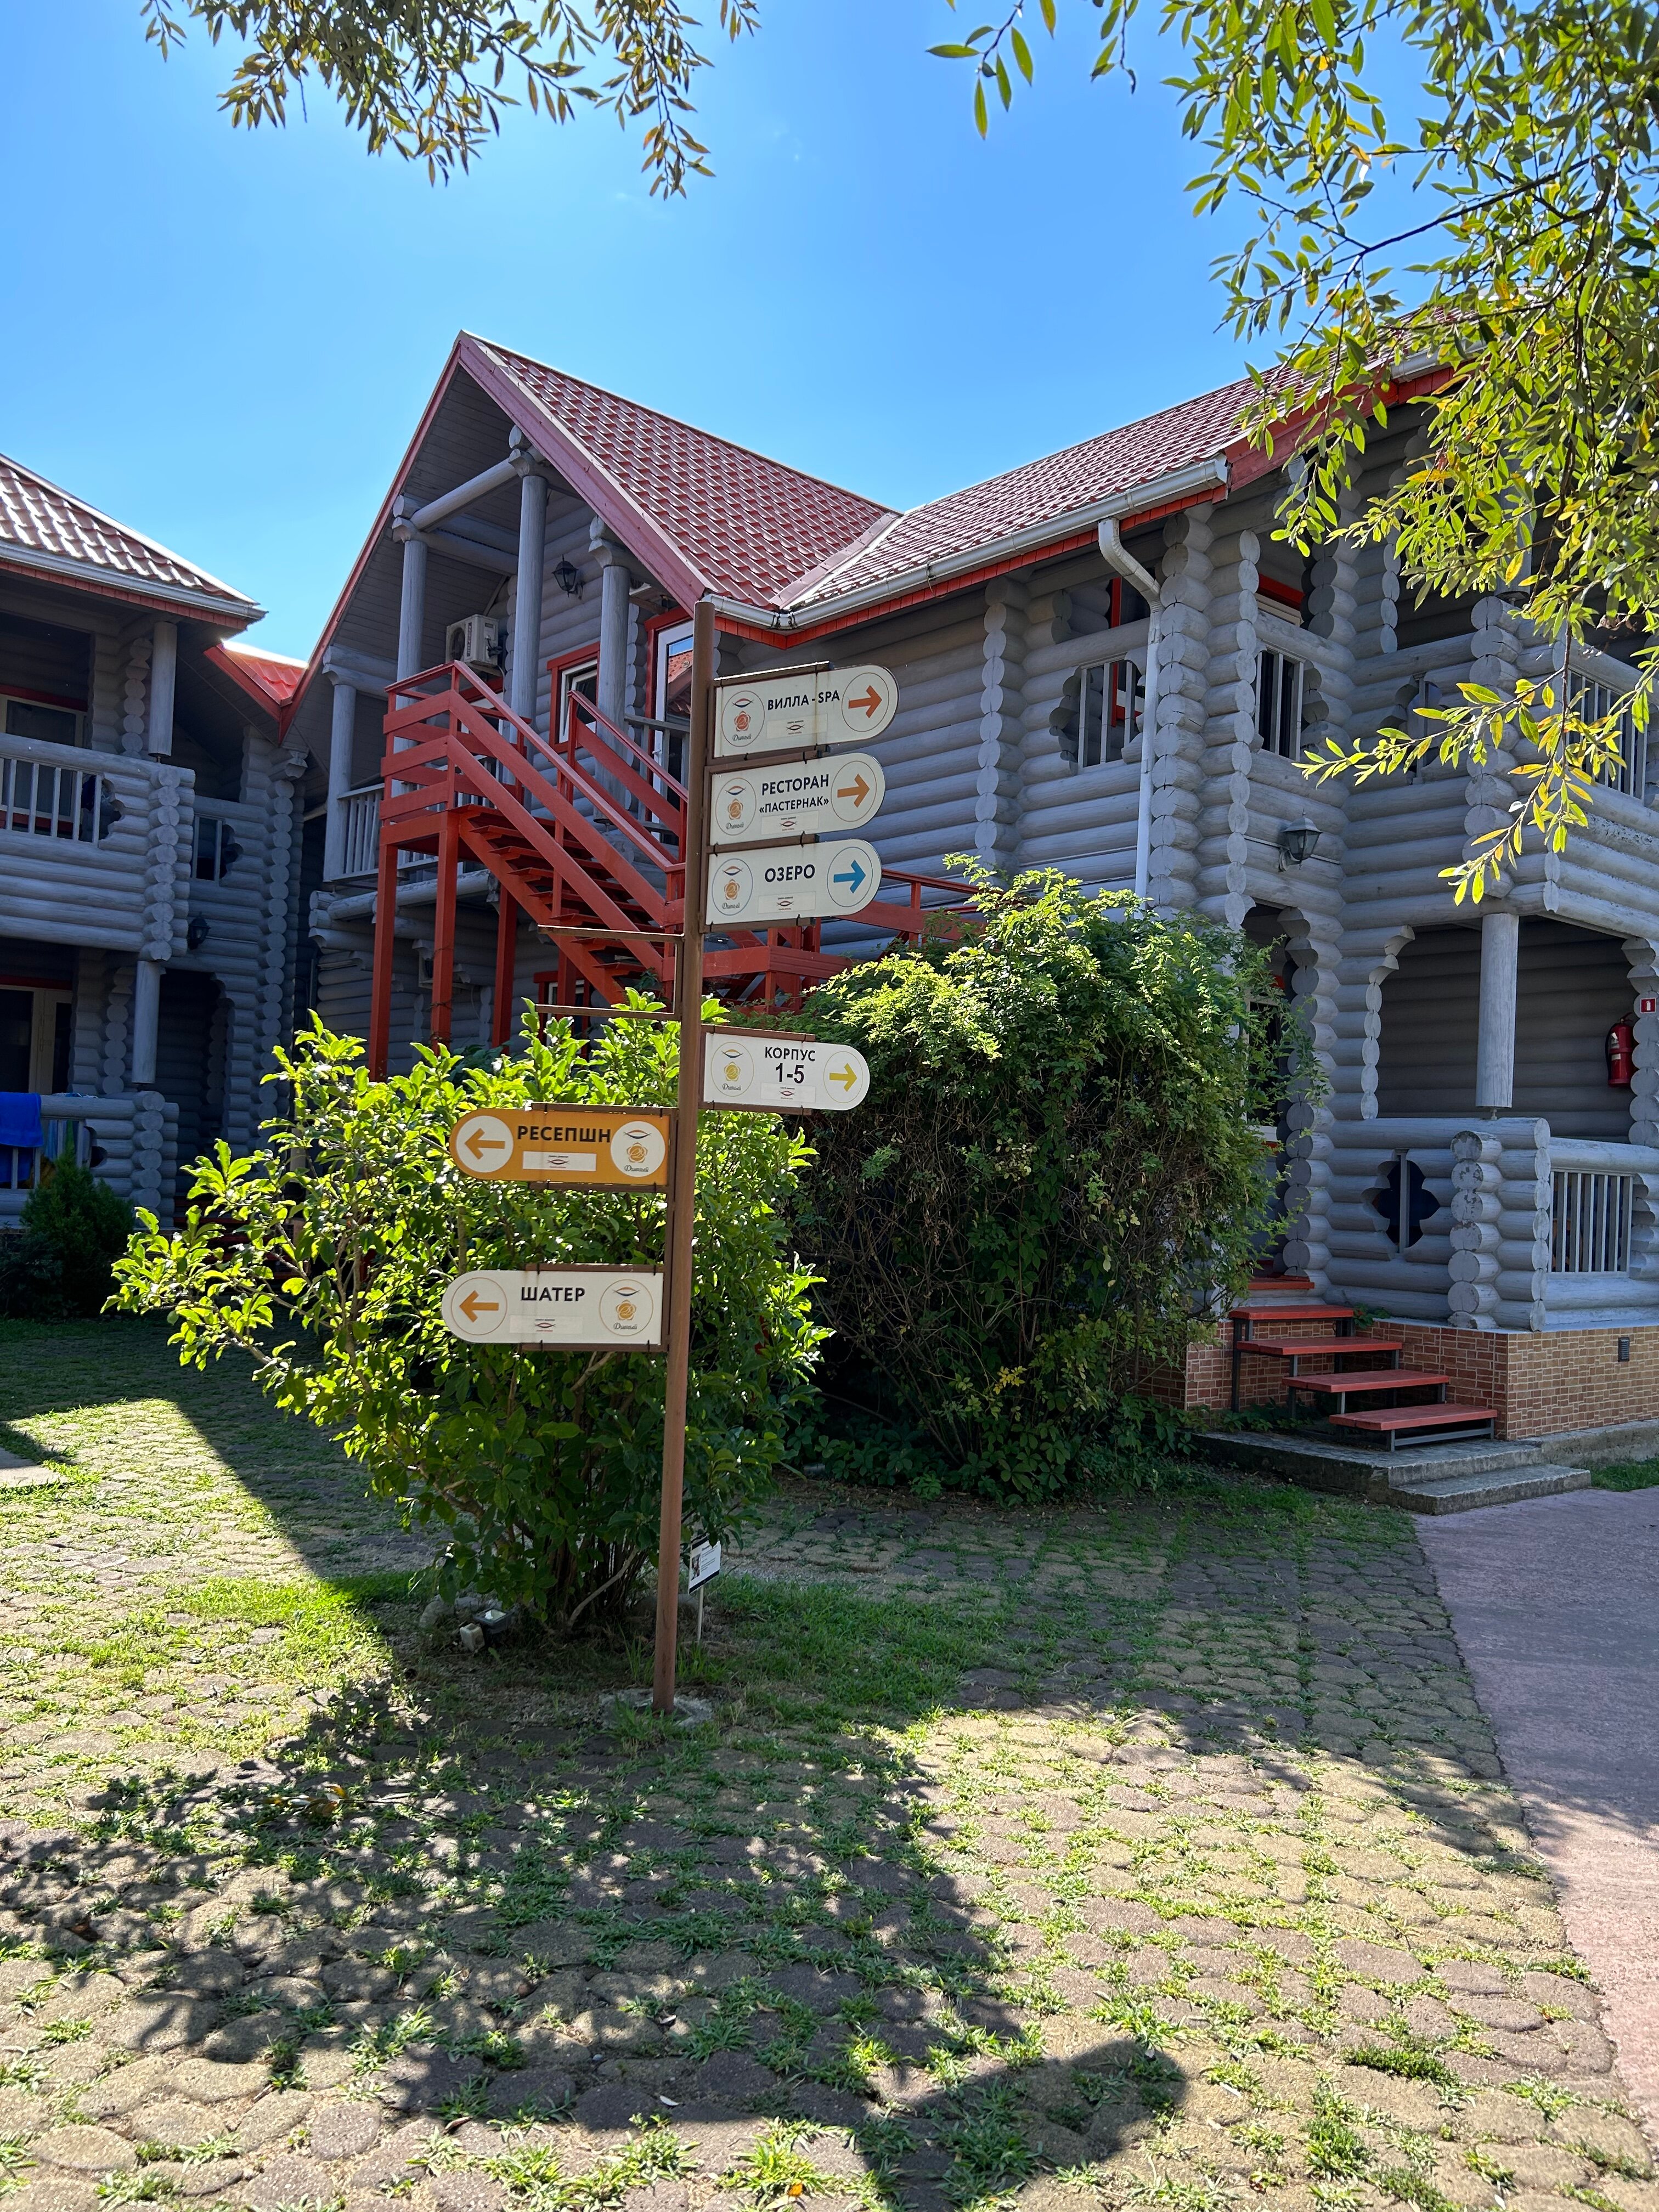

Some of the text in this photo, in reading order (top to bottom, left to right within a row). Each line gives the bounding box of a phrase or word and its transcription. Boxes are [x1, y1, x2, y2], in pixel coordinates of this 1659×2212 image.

[762, 774, 829, 795] РЕСТОРАН
[759, 795, 830, 813] «ПАСТЕРНАК»
[765, 864, 815, 883] ОЗЕРО
[765, 1046, 816, 1062] КОРПУС
[775, 1063, 804, 1084] 1-5
[517, 1125, 611, 1143] РЕСЕПШН
[521, 1286, 585, 1301] ШАТЕР
